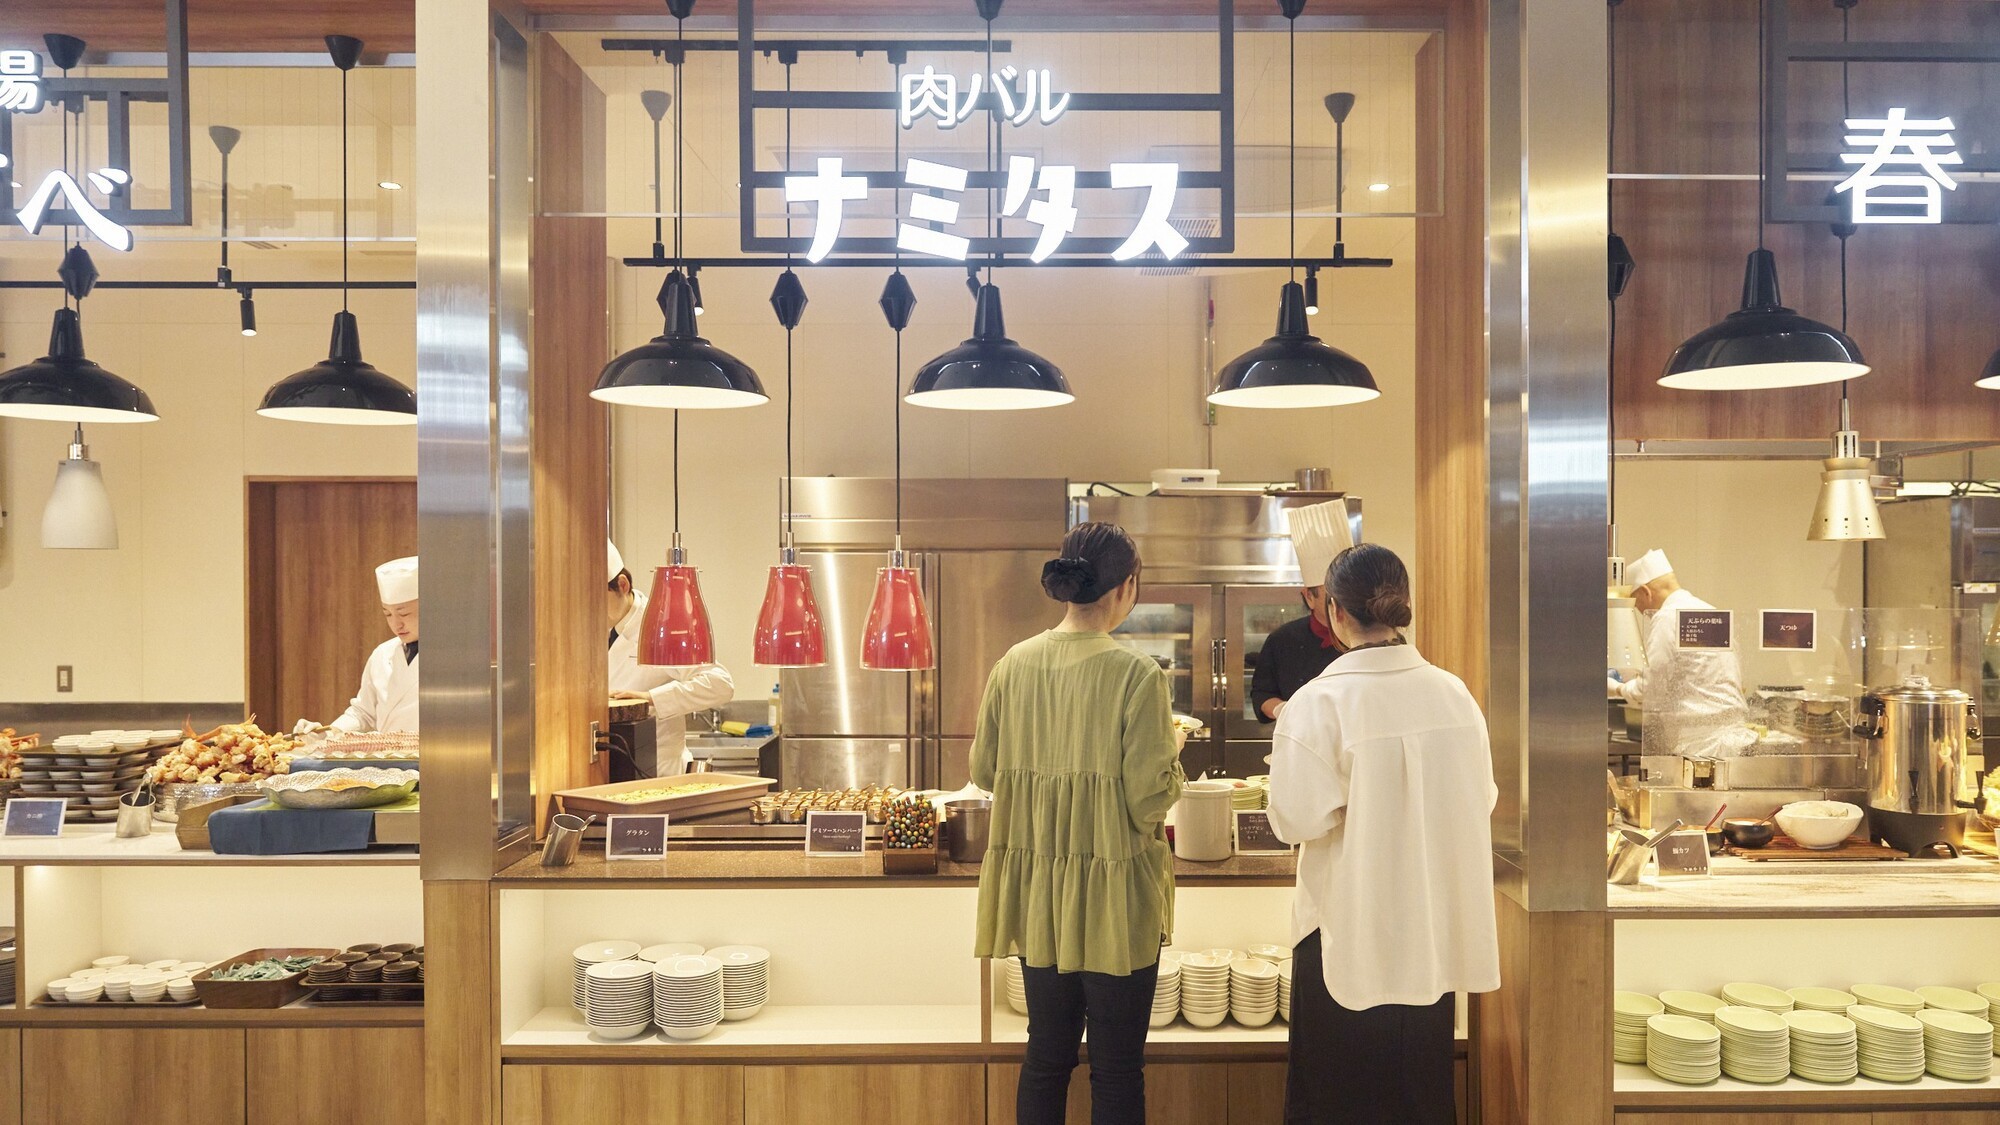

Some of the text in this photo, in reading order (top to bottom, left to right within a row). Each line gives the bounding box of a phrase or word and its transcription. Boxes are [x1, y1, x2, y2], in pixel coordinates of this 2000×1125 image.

[901, 65, 1071, 128] 肉バル
[0, 153, 133, 251] べ
[784, 155, 1191, 265] ナミタス
[1833, 107, 1964, 224] 春
[625, 829, 650, 837] グラタン
